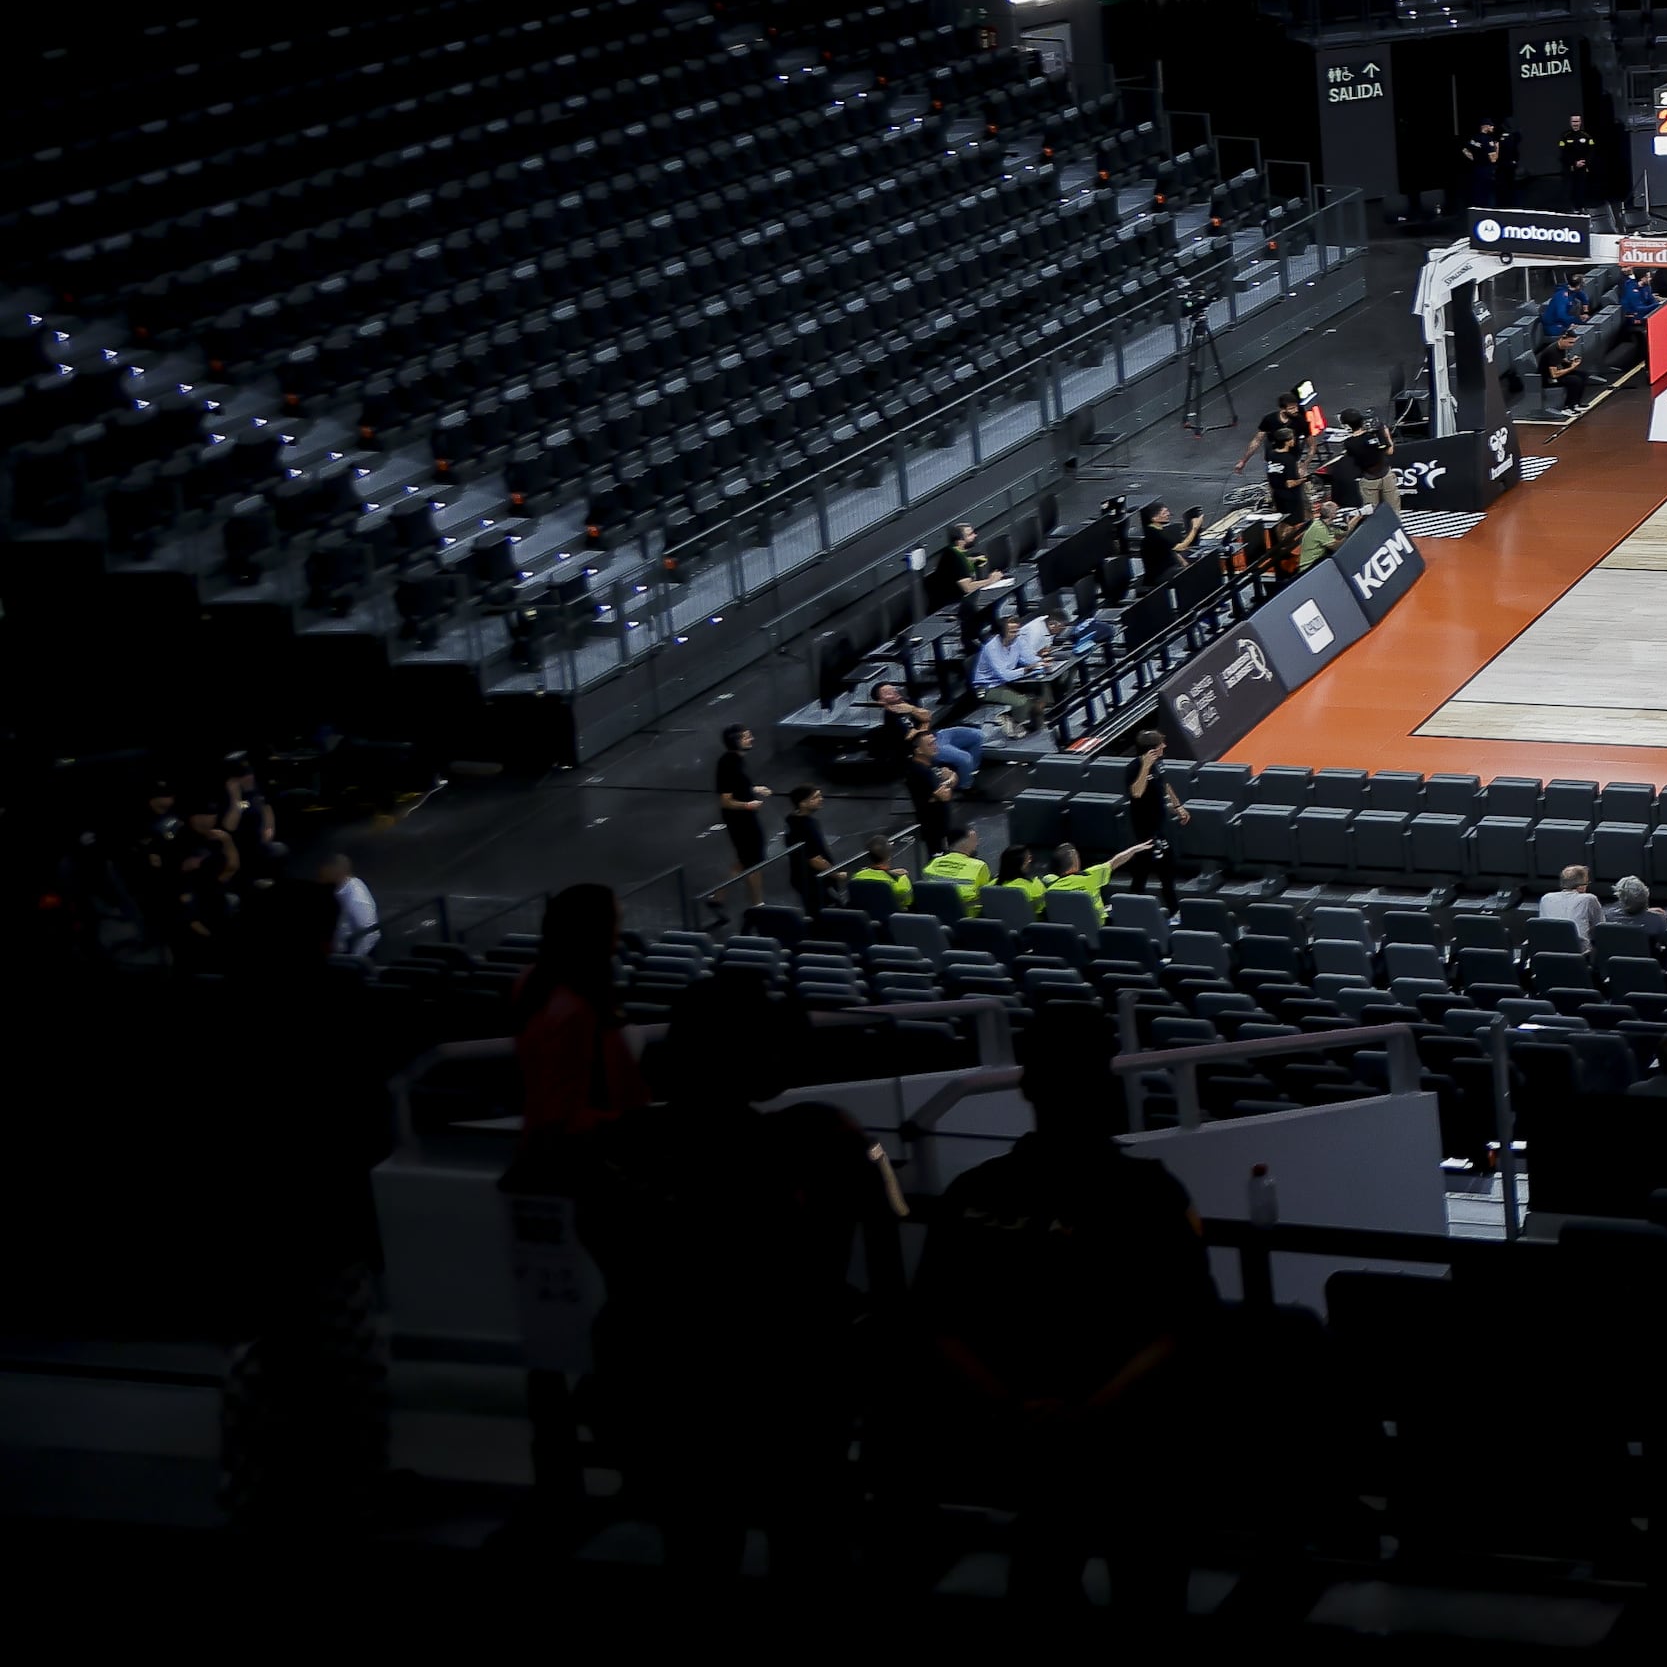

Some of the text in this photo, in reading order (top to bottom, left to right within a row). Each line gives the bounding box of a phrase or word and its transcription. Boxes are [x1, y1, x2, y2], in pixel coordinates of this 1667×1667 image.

[1520, 59, 1573, 79] SALIDA
[1328, 82, 1384, 103] SALIDA
[1503, 225, 1581, 243] motorola
[1622, 249, 1652, 264] abu
[1352, 528, 1414, 600] KGM
